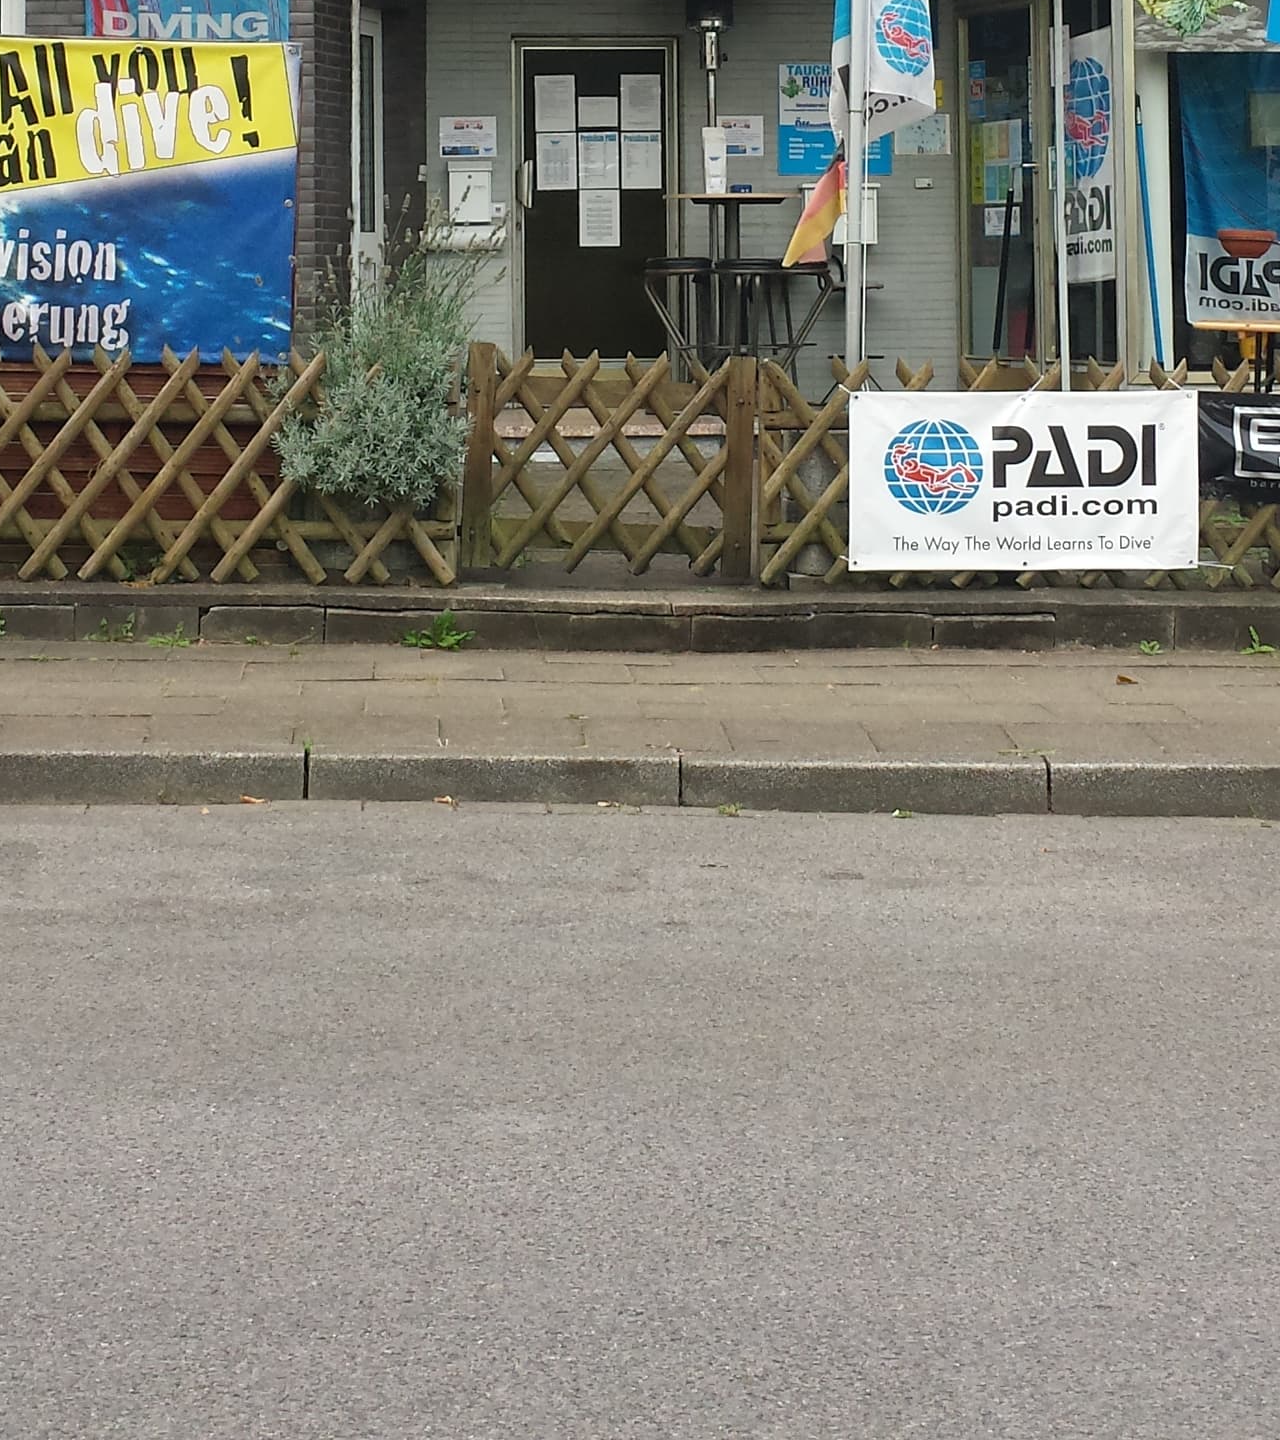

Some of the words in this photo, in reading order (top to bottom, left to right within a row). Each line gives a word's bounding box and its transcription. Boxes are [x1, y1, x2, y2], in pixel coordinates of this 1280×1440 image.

[93, 46, 199, 98] you
[809, 88, 831, 98] DIV
[992, 424, 1157, 488] PADI
[993, 495, 1158, 522] padi.com
[893, 536, 919, 551] The
[924, 537, 959, 554] Way
[964, 536, 991, 551] The
[996, 536, 1041, 551] World
[1047, 536, 1093, 550] Learns
[1099, 536, 1114, 550] To
[1119, 535, 1152, 550] Dive
